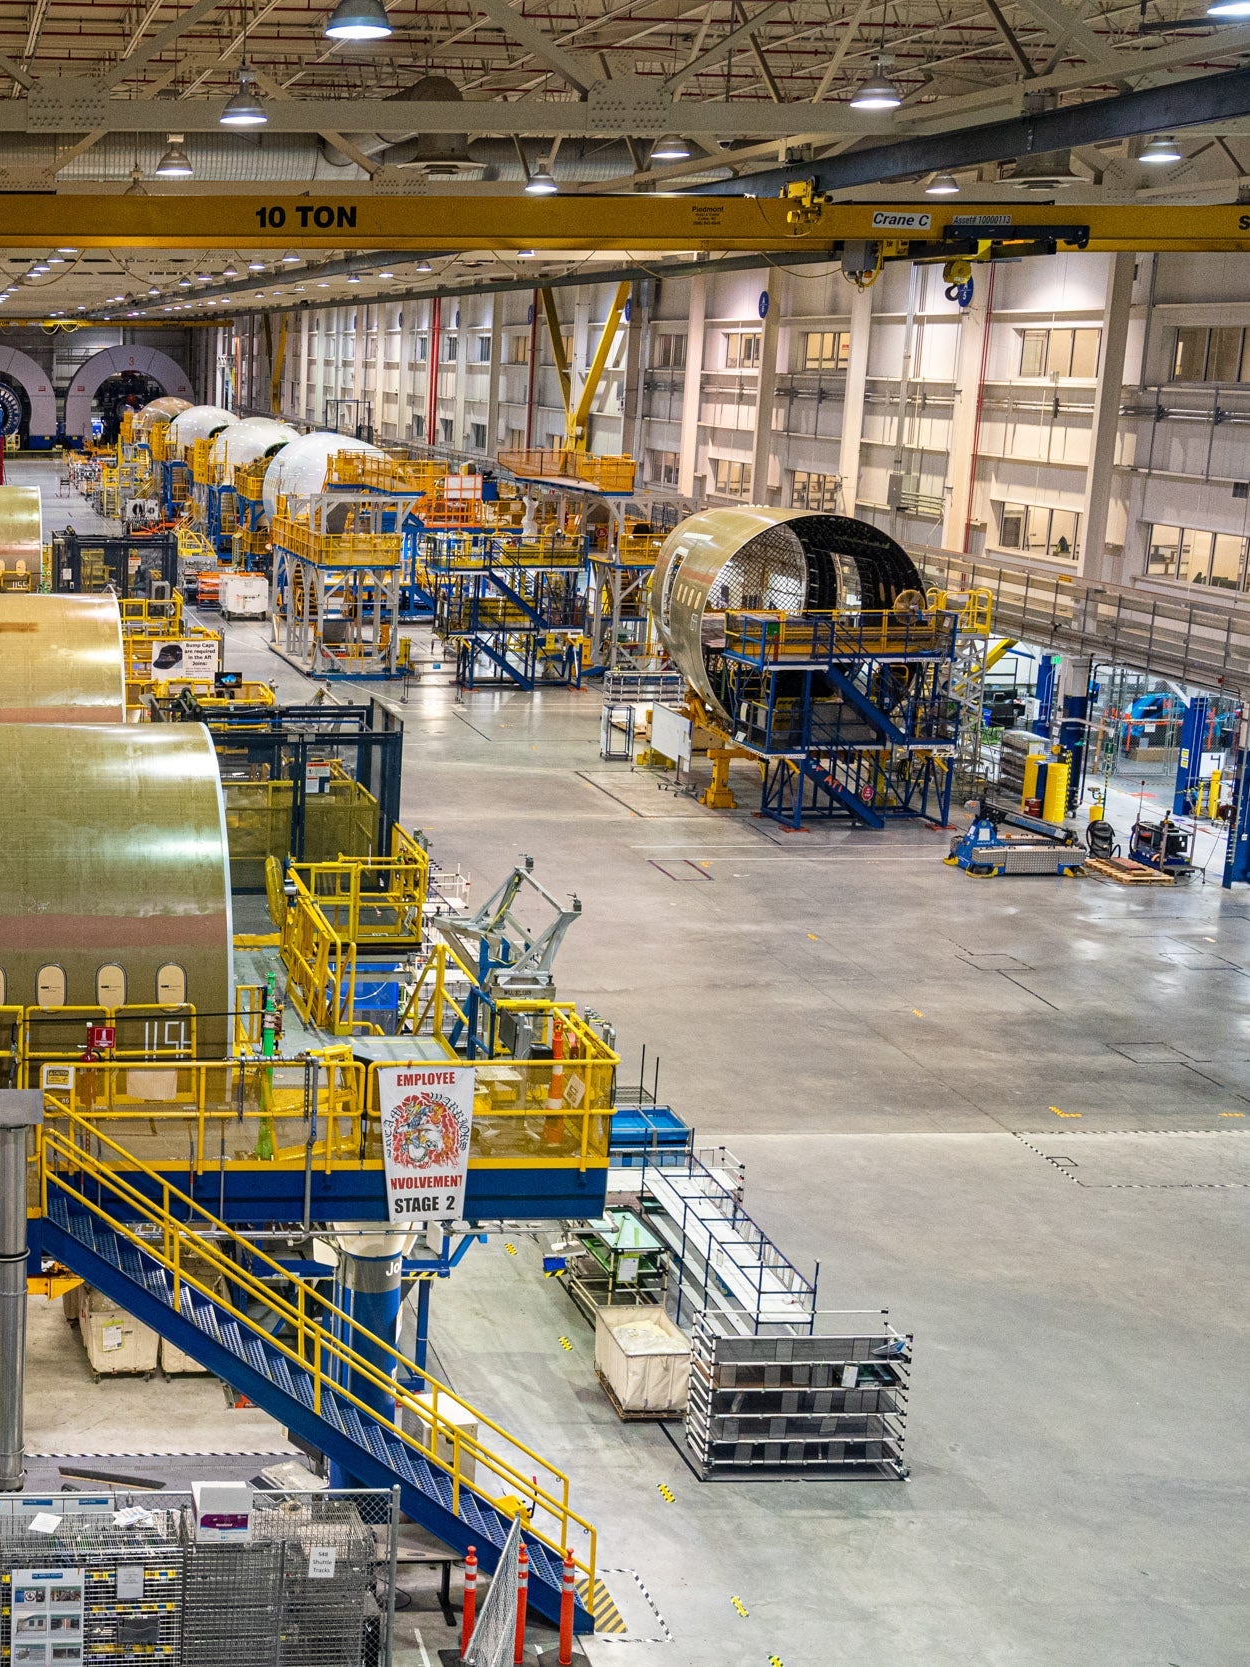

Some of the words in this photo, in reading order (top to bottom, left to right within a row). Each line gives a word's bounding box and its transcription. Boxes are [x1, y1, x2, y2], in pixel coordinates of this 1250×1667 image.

[256, 205, 286, 228] 10
[295, 205, 357, 228] TON
[873, 212, 914, 226] Crane
[918, 214, 929, 227] C
[953, 215, 976, 225] Asset#
[978, 215, 1011, 225] 10000113
[129, 356, 135, 366] 3
[396, 1071, 456, 1087] EMPLOYEE
[394, 1196, 440, 1214] STAGE
[445, 1195, 456, 1211] 2
